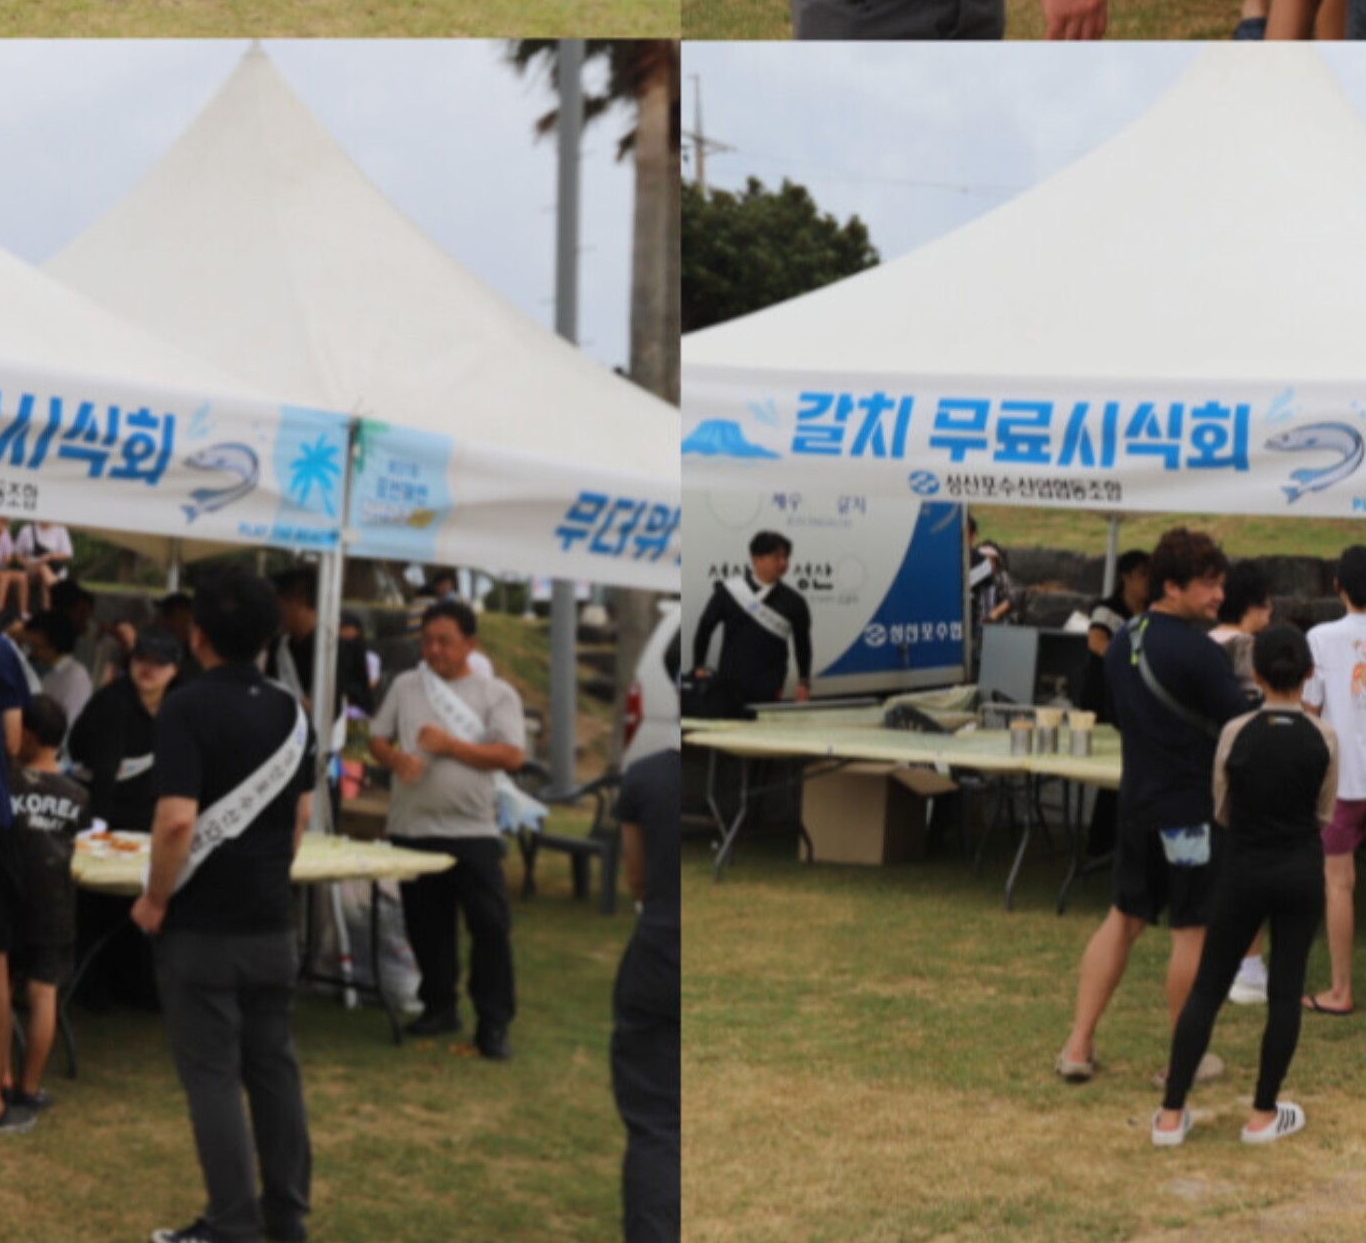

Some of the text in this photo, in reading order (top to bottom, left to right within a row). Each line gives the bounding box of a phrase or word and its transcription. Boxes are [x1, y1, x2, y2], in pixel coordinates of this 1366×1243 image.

[791, 392, 1251, 472] 갈치 무료시식회
[946, 473, 1122, 502] 성산포수산업협동조합
